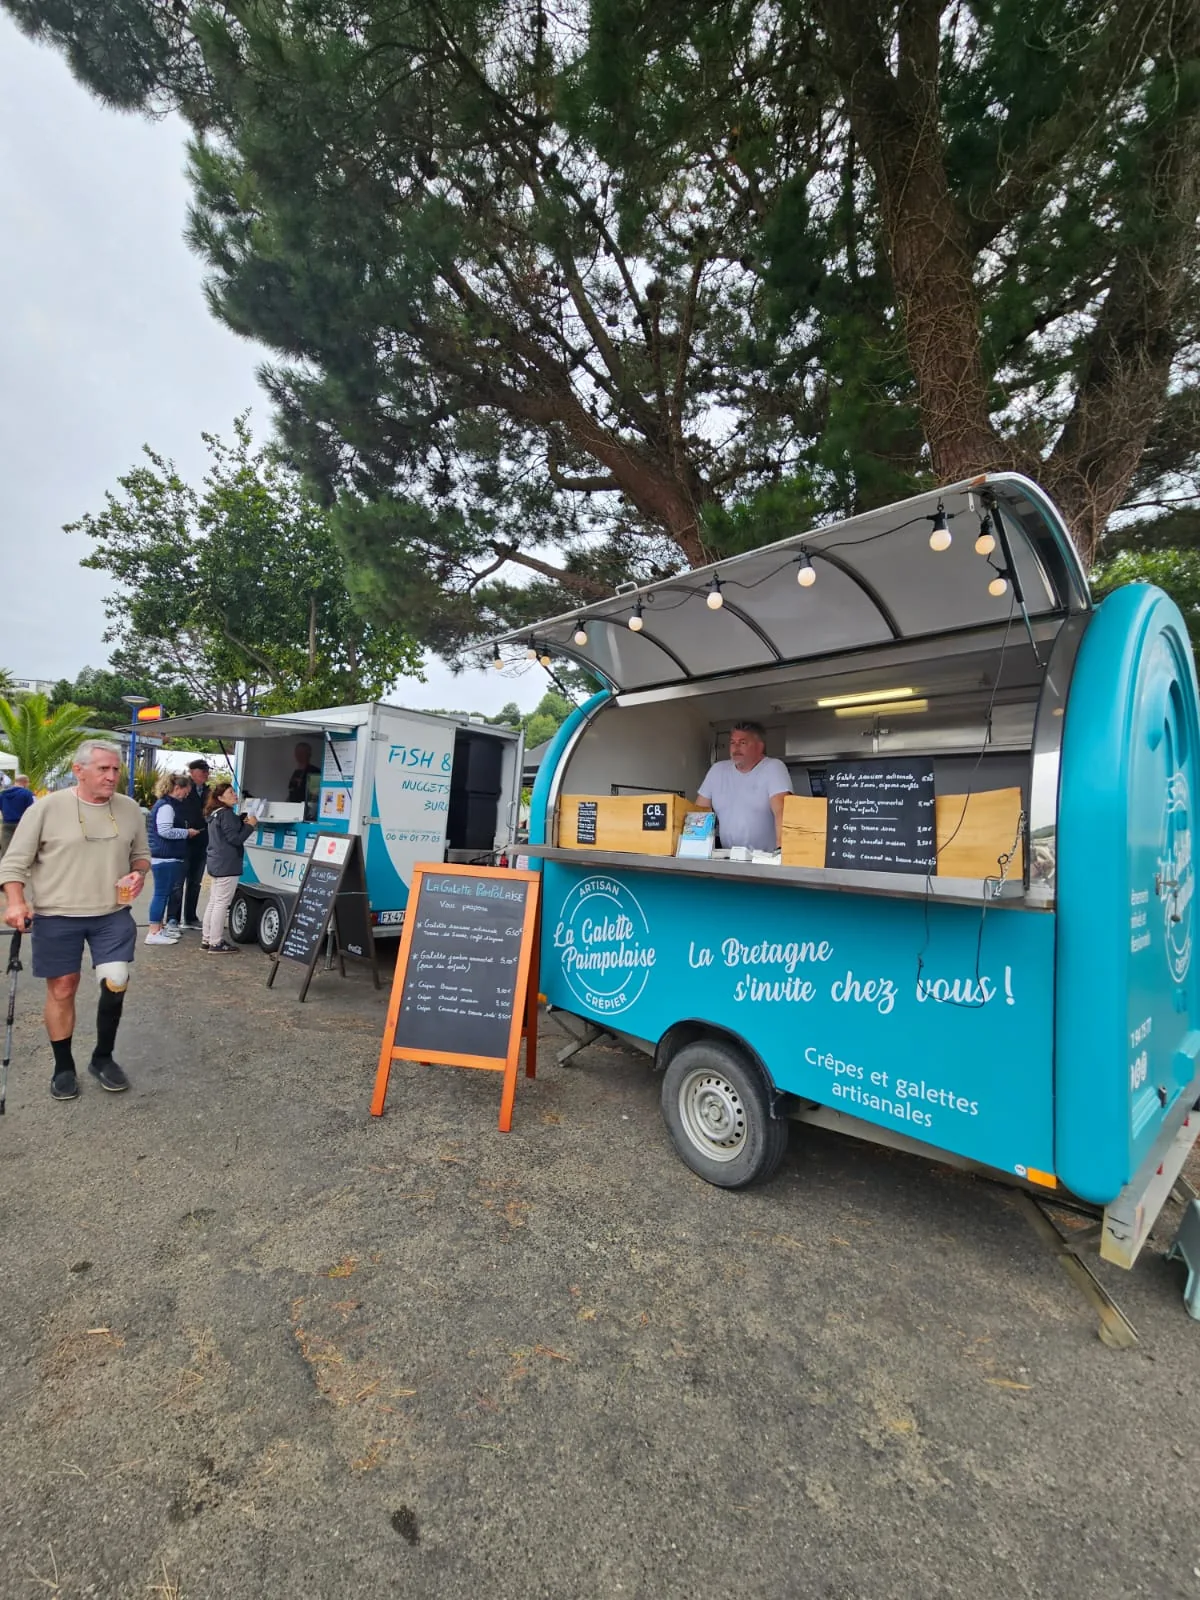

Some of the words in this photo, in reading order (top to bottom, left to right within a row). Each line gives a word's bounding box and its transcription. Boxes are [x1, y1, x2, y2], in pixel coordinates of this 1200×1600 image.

[388, 745, 435, 769] FISH
[440, 752, 452, 772] &
[646, 805, 661, 816] CB
[579, 880, 620, 897] ARTISAN
[553, 921, 575, 948] La
[582, 913, 635, 945] Galette
[561, 941, 656, 977] Paimpolaise
[688, 941, 714, 969] La
[721, 937, 833, 974] Bretagne
[733, 974, 816, 1003] s'invite
[831, 971, 898, 1014] chez
[915, 975, 997, 1003] vous
[1004, 966, 1015, 1006] !
[804, 1047, 864, 1080] Crêpes
[870, 1071, 889, 1088] et
[895, 1078, 979, 1116] galettes
[831, 1081, 932, 1128] artisanales
